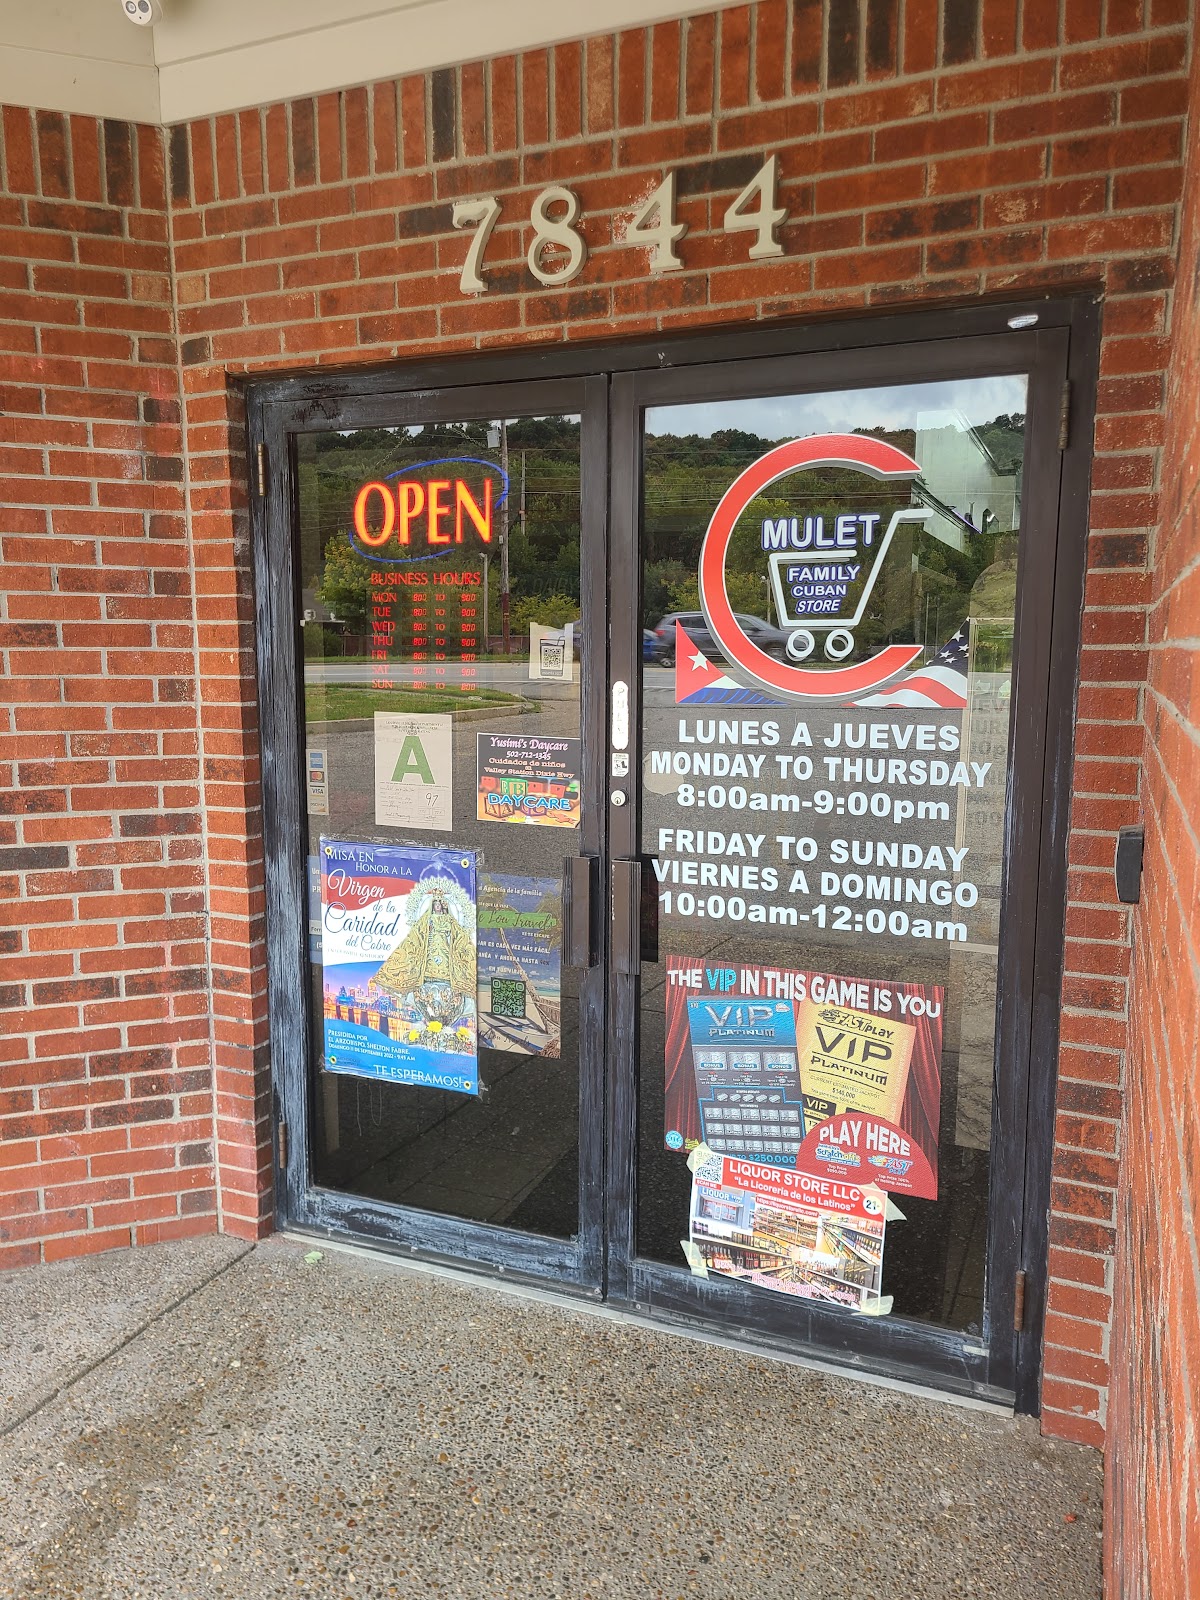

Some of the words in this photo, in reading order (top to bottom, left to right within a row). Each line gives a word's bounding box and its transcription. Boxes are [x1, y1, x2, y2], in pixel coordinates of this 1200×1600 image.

[452, 154, 789, 294] 7844
[353, 478, 493, 547] OPEN
[762, 515, 880, 549] MULET
[371, 572, 428, 586] BUSINESS
[433, 571, 481, 585] HOURS
[787, 565, 860, 583] FAMILY
[371, 592, 397, 602] MON
[792, 584, 847, 598] CUBAN
[372, 606, 391, 617] TUE
[796, 599, 840, 613] STORE
[371, 621, 396, 632] WED
[372, 636, 393, 646] THU
[371, 650, 387, 660] FRI
[371, 664, 390, 674] SAT
[371, 678, 393, 689] SUN
[679, 719, 780, 745] LUNES
[791, 722, 813, 746] A
[824, 723, 960, 750] JUEVES
[490, 737, 527, 749] Yusimi's
[529, 739, 568, 752] Daycare
[391, 735, 436, 785] A
[488, 757, 527, 765] Cuidados
[484, 767, 507, 775] Valley
[651, 750, 766, 777] MONDAY
[776, 755, 813, 780] TO
[823, 757, 992, 787] THURSDAY
[487, 793, 571, 810] DAYCARE
[677, 784, 950, 823] 8:00am-9:00pm
[327, 850, 357, 862] MISA
[359, 851, 374, 862] EN
[658, 828, 766, 857] FRIDAY
[776, 836, 818, 861] TO
[830, 839, 970, 871] SUNDAY
[355, 862, 389, 874] HONOR
[391, 866, 398, 874] A
[400, 867, 412, 875] LA
[327, 869, 386, 904] Virgen
[651, 858, 779, 891] VIERNES
[789, 870, 810, 894] A
[821, 872, 979, 908] DOMINGO
[372, 900, 383, 912] de
[386, 901, 397, 913] la
[324, 901, 401, 937] Caridad
[658, 891, 968, 942] 10:00am-12:00am
[345, 934, 358, 948] del
[361, 936, 391, 951] Cobre
[667, 969, 703, 988] THE
[705, 968, 736, 991] VIP
[740, 970, 760, 995] IN
[764, 970, 806, 1001] THIS
[810, 976, 868, 1009] GAME
[873, 986, 892, 1012] IS
[897, 991, 940, 1019] YOU
[705, 1005, 774, 1027] VIP
[328, 1028, 356, 1040] PRESIDIDA
[708, 1027, 775, 1038] PLATINUM
[328, 1043, 349, 1051] DOMINGO
[367, 1042, 390, 1052] SHELTON
[814, 1026, 893, 1063] VIP
[373, 1065, 388, 1075] TE
[390, 1068, 463, 1089] ESPERAMOS!
[810, 1055, 889, 1086] PLATINUM
[806, 1097, 828, 1111] VIP
[819, 1120, 861, 1148] PLAY
[866, 1122, 911, 1157] HERE
[696, 1179, 709, 1187] SCAN
[729, 1161, 781, 1183] LIQUOR
[784, 1173, 829, 1196] STORE
[832, 1183, 860, 1201] LLC
[702, 1187, 730, 1200] LIQUOR
[790, 1188, 802, 1200] de
[803, 1191, 816, 1204] los
